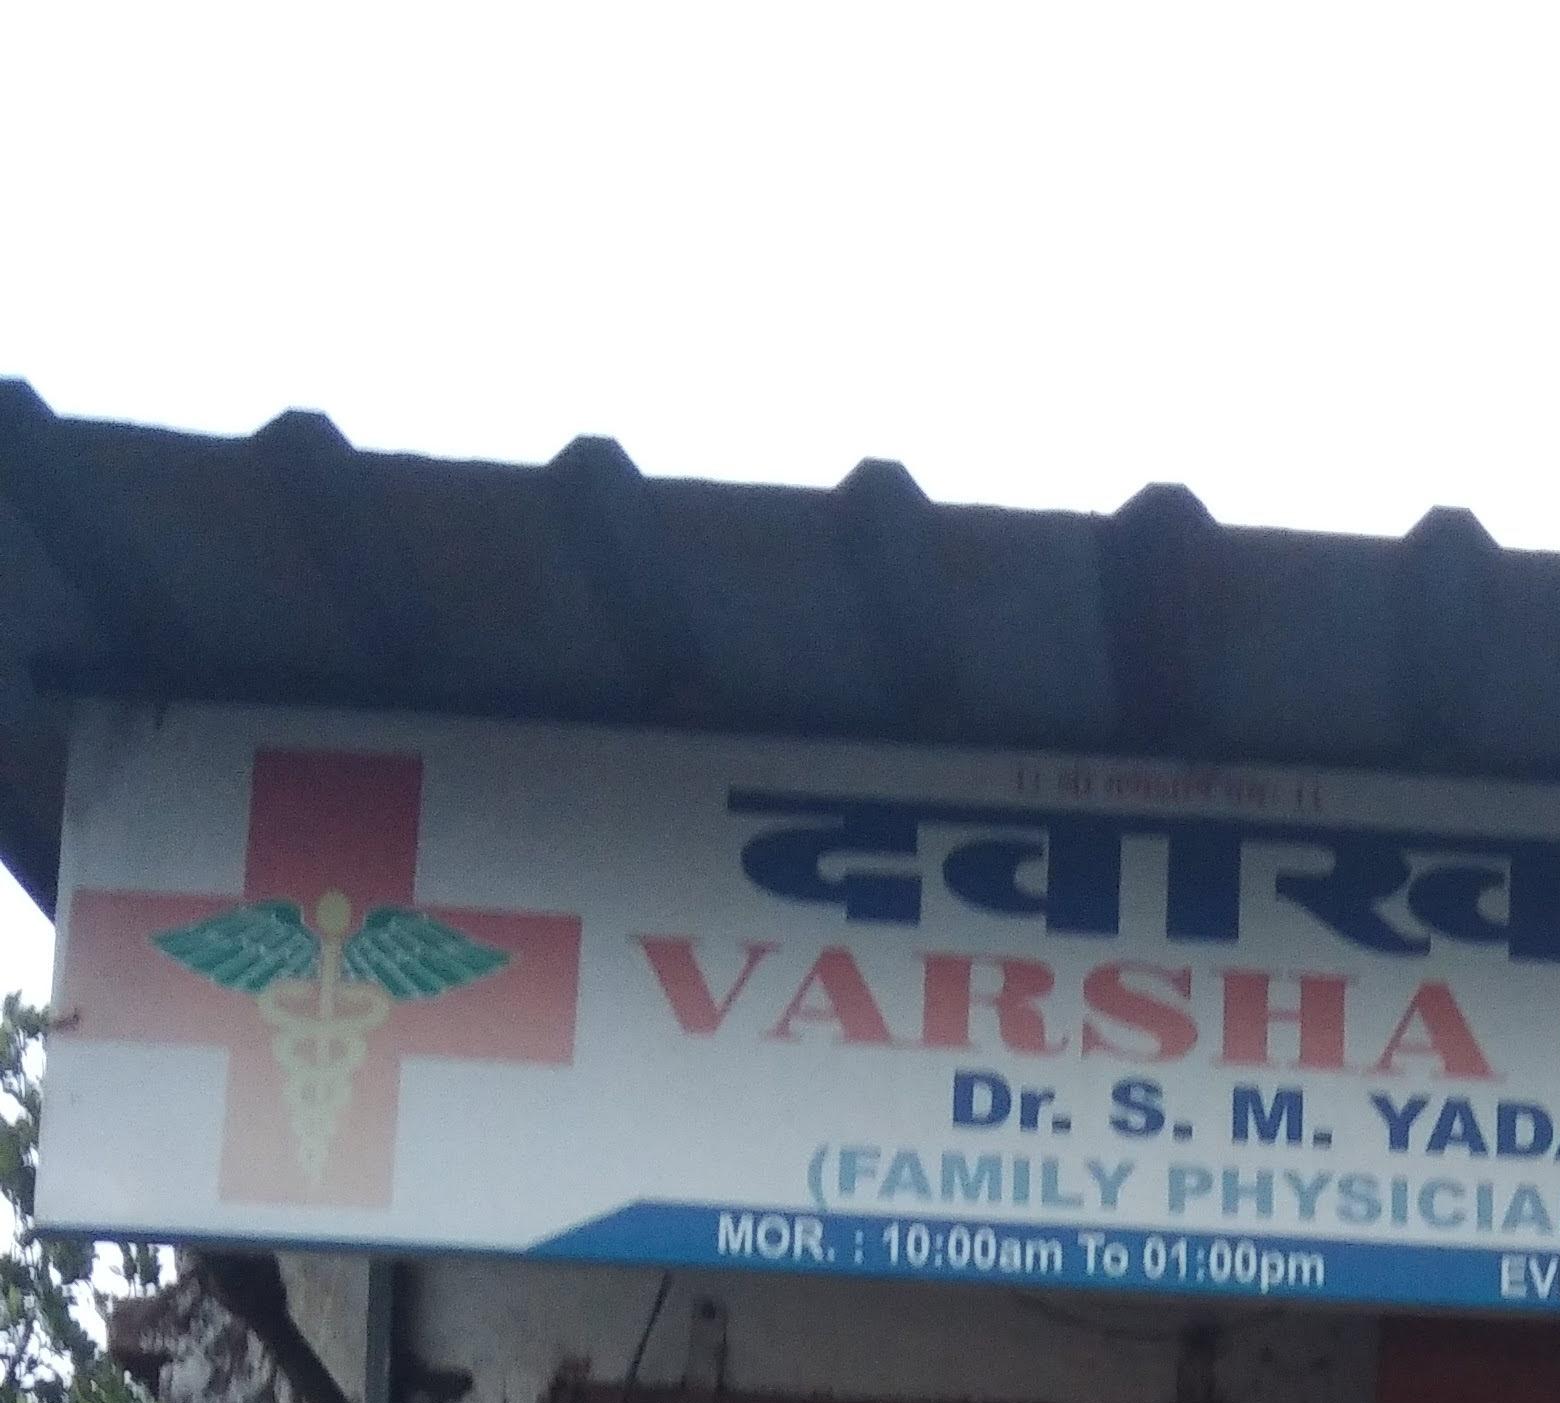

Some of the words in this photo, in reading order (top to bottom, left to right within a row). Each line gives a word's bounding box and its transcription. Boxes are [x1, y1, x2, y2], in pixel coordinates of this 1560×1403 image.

[630, 931, 1506, 1083] VARSHA
[952, 1068, 1072, 1134] Dr.
[1109, 1076, 1194, 1141] S.
[1230, 1081, 1333, 1150] M.
[806, 1143, 1136, 1212] (FAMILY
[715, 1211, 837, 1265] MOR.
[882, 1222, 1064, 1275] 10:00am
[1077, 1231, 1130, 1276] To
[1143, 1233, 1326, 1295] 01:00pm
